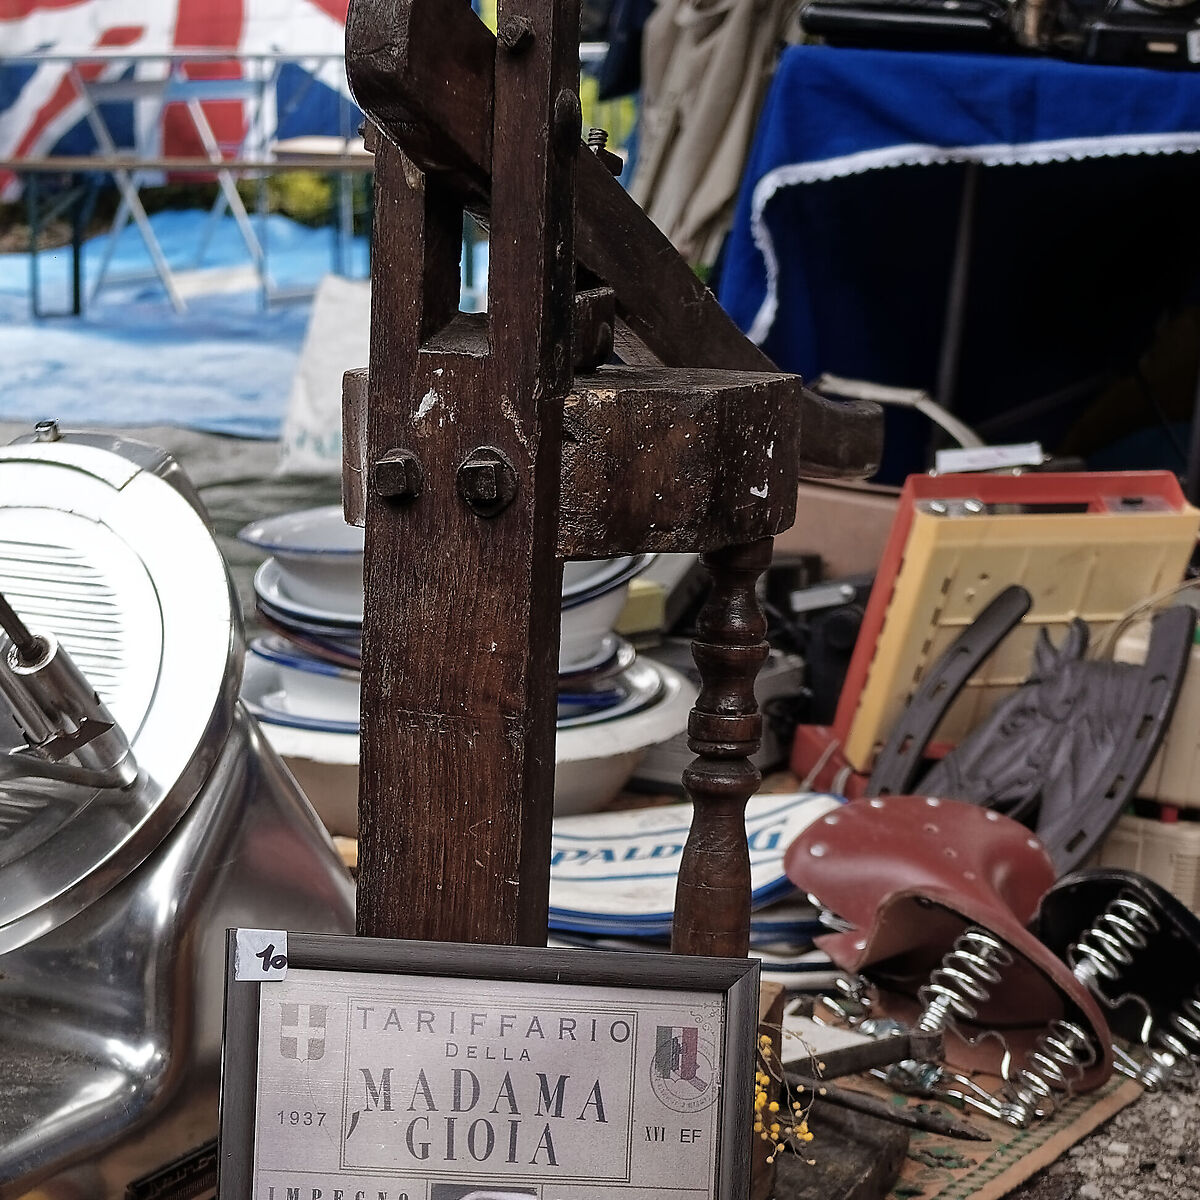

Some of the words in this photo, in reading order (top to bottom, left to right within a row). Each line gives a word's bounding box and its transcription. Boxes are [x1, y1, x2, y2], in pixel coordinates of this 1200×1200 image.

[255, 943, 288, 972] 10
[356, 1005, 633, 1045] TARIFFARIO
[445, 1042, 531, 1062] DELLA
[358, 1067, 609, 1125] MADAMA
[277, 1110, 327, 1127] 1937
[405, 1115, 560, 1167] GIOIA
[644, 1125, 666, 1142] XVI
[679, 1128, 703, 1144] EF
